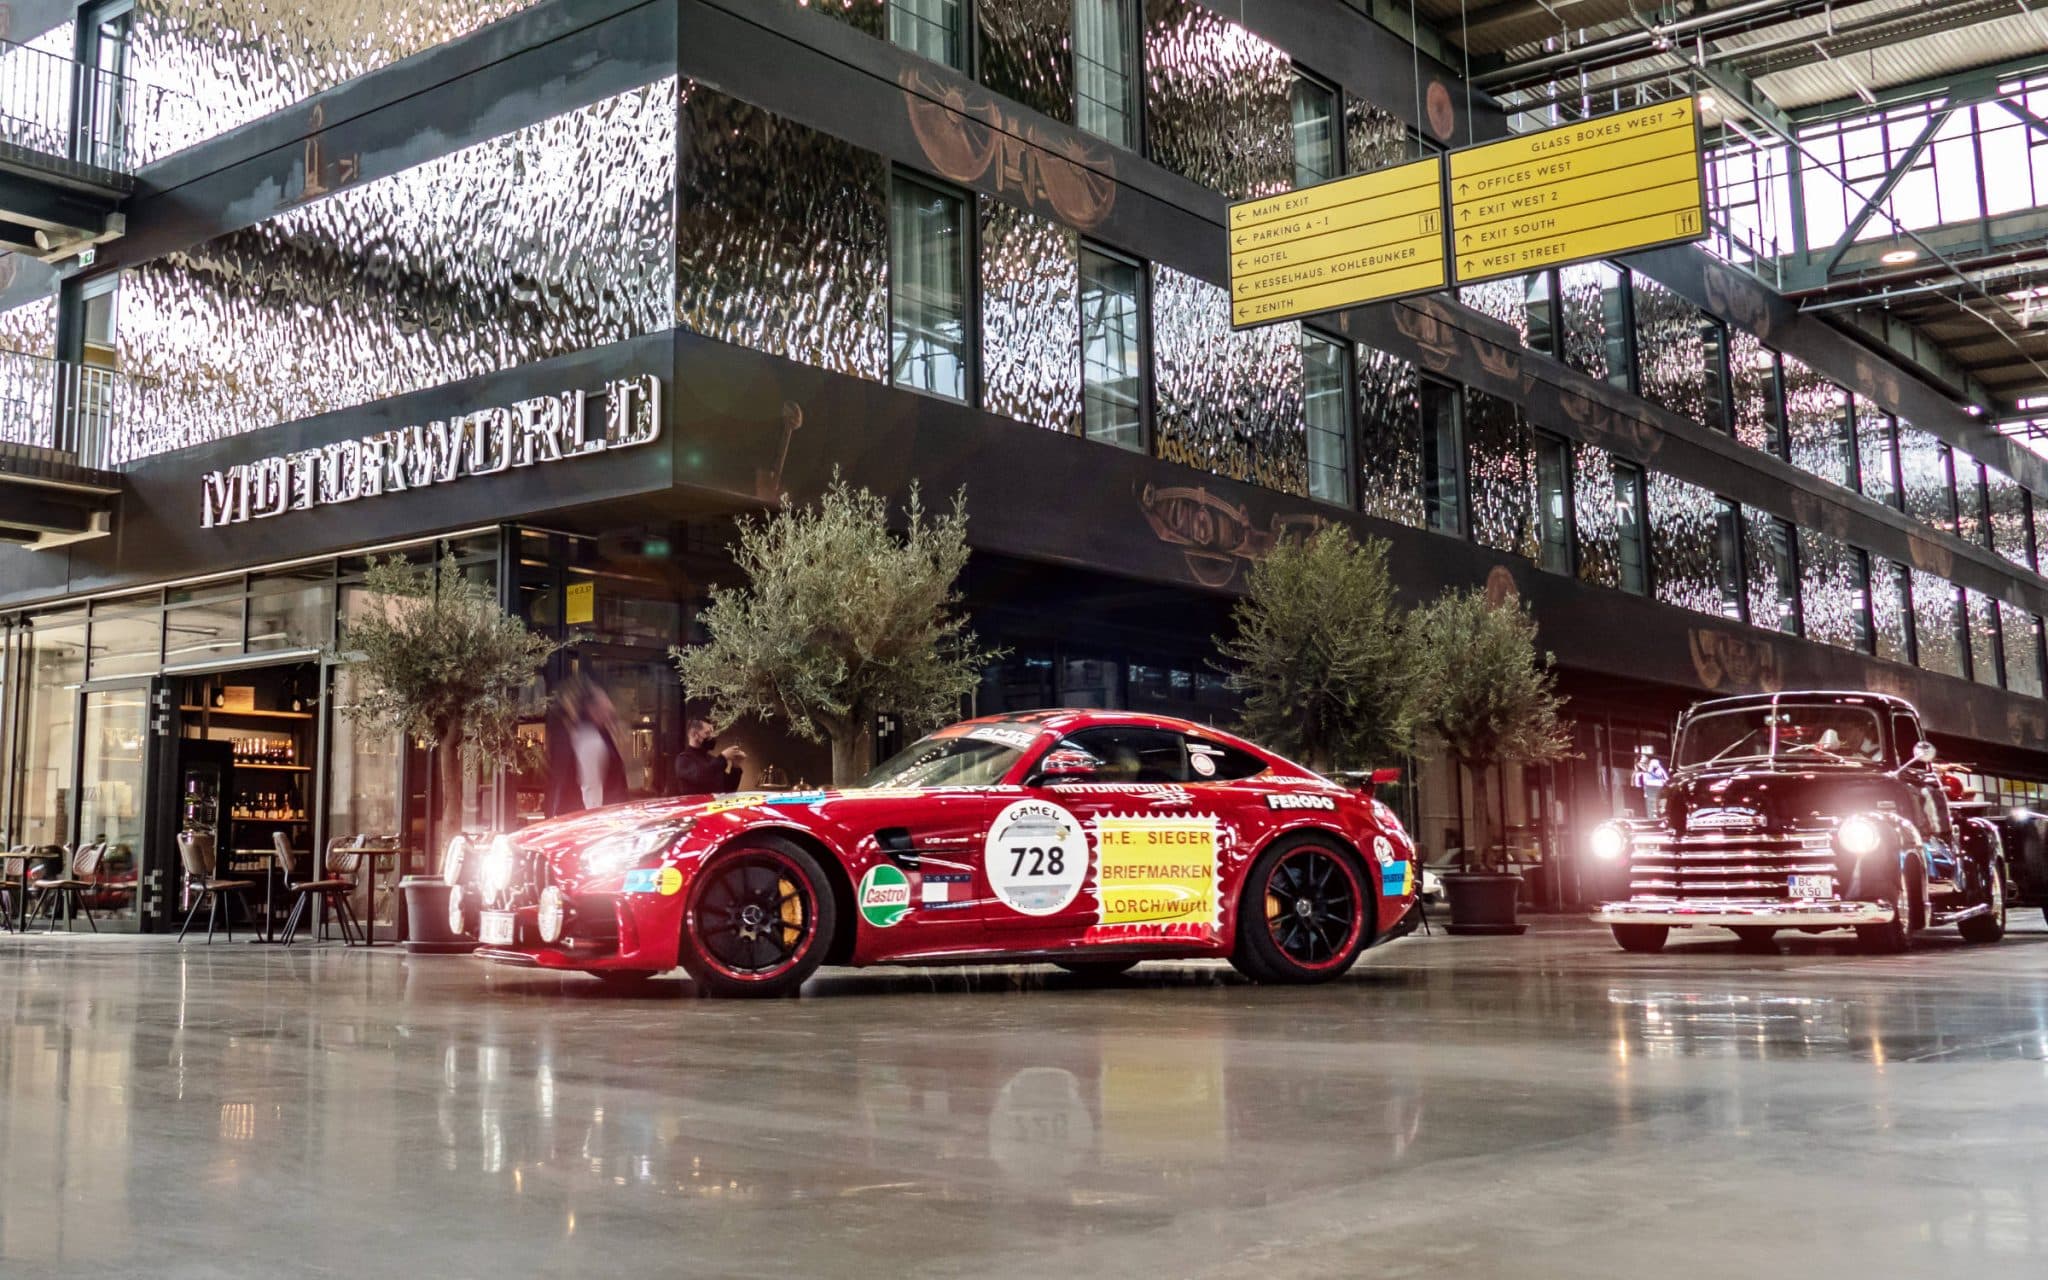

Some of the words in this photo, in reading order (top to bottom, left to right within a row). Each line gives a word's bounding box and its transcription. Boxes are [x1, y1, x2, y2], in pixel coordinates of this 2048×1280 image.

[1531, 135, 1571, 152] GLASS
[1577, 123, 1621, 142] BOXES
[1628, 113, 1664, 129] WEST
[1477, 170, 1532, 191] OFFICES
[1538, 161, 1572, 176] WEST
[1253, 205, 1281, 217] MAIN
[1286, 196, 1310, 210] EXIT
[1479, 202, 1506, 217] EXIT
[1512, 193, 1546, 209] WEST
[1551, 191, 1559, 201] 2
[1253, 223, 1301, 242] PARKING
[1306, 222, 1312, 230] A
[1480, 228, 1507, 242] EXIT
[1514, 218, 1556, 236] SOUTH
[1254, 250, 1288, 265] HOTEL
[1331, 247, 1416, 274] KOHLEBUNKER
[1483, 253, 1517, 268] WEST
[1522, 242, 1567, 261] STREET
[1255, 299, 1294, 314] ZENITH
[200, 373, 662, 529] MOTORWORLD
[1053, 783, 1185, 794] MOTORWORLD
[1266, 794, 1336, 811] FERODO
[1010, 806, 1060, 821] CAMEL
[1103, 831, 1137, 845] H.E.
[1148, 831, 1211, 845] SIEGER
[1010, 846, 1065, 877] 728
[1102, 864, 1212, 880] BRIEFMARKEN
[866, 887, 908, 904] Castrol
